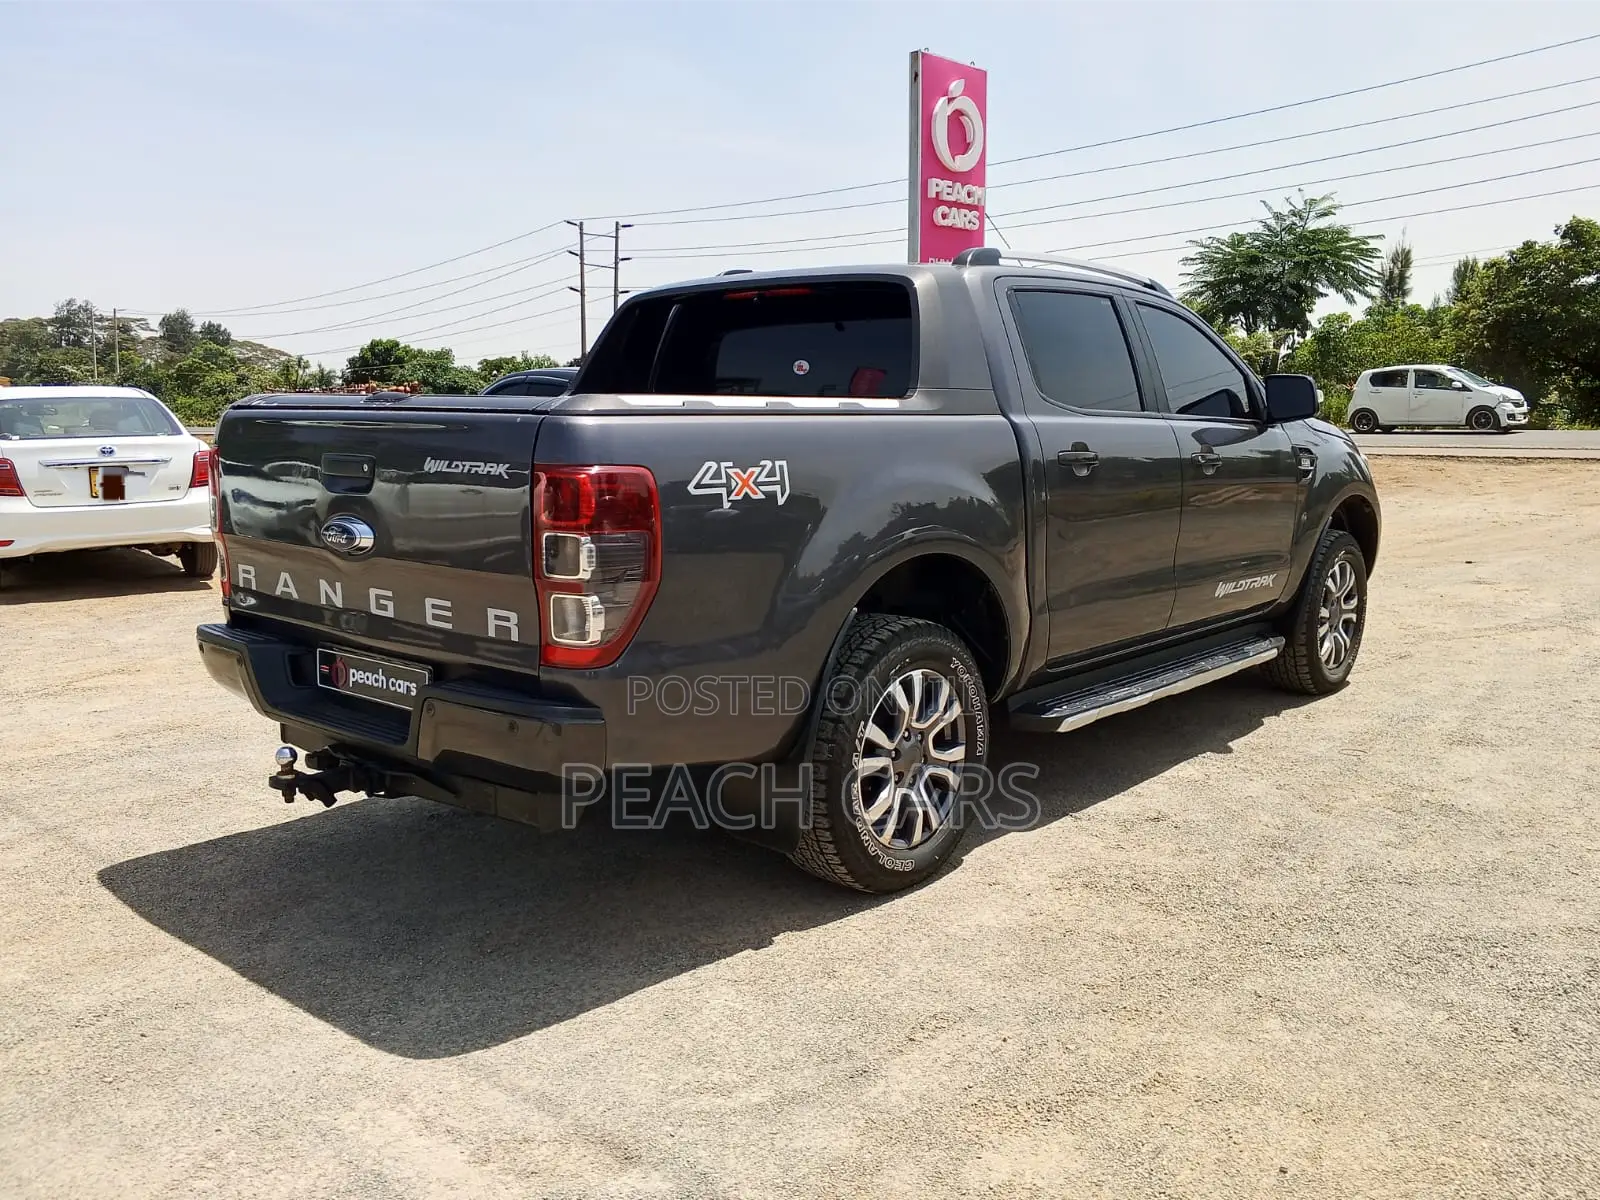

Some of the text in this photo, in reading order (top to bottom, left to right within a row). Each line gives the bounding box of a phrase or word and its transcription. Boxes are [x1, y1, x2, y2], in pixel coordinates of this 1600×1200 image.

[928, 178, 985, 206] PEACH
[933, 205, 980, 231] CARS
[423, 456, 511, 480] WILDTRAK
[322, 526, 348, 544] Ford
[1214, 573, 1278, 598] WILDTRAK
[237, 563, 520, 643] RANGER
[349, 668, 417, 697] peach cars
[950, 657, 985, 757] YOKOHAMA
